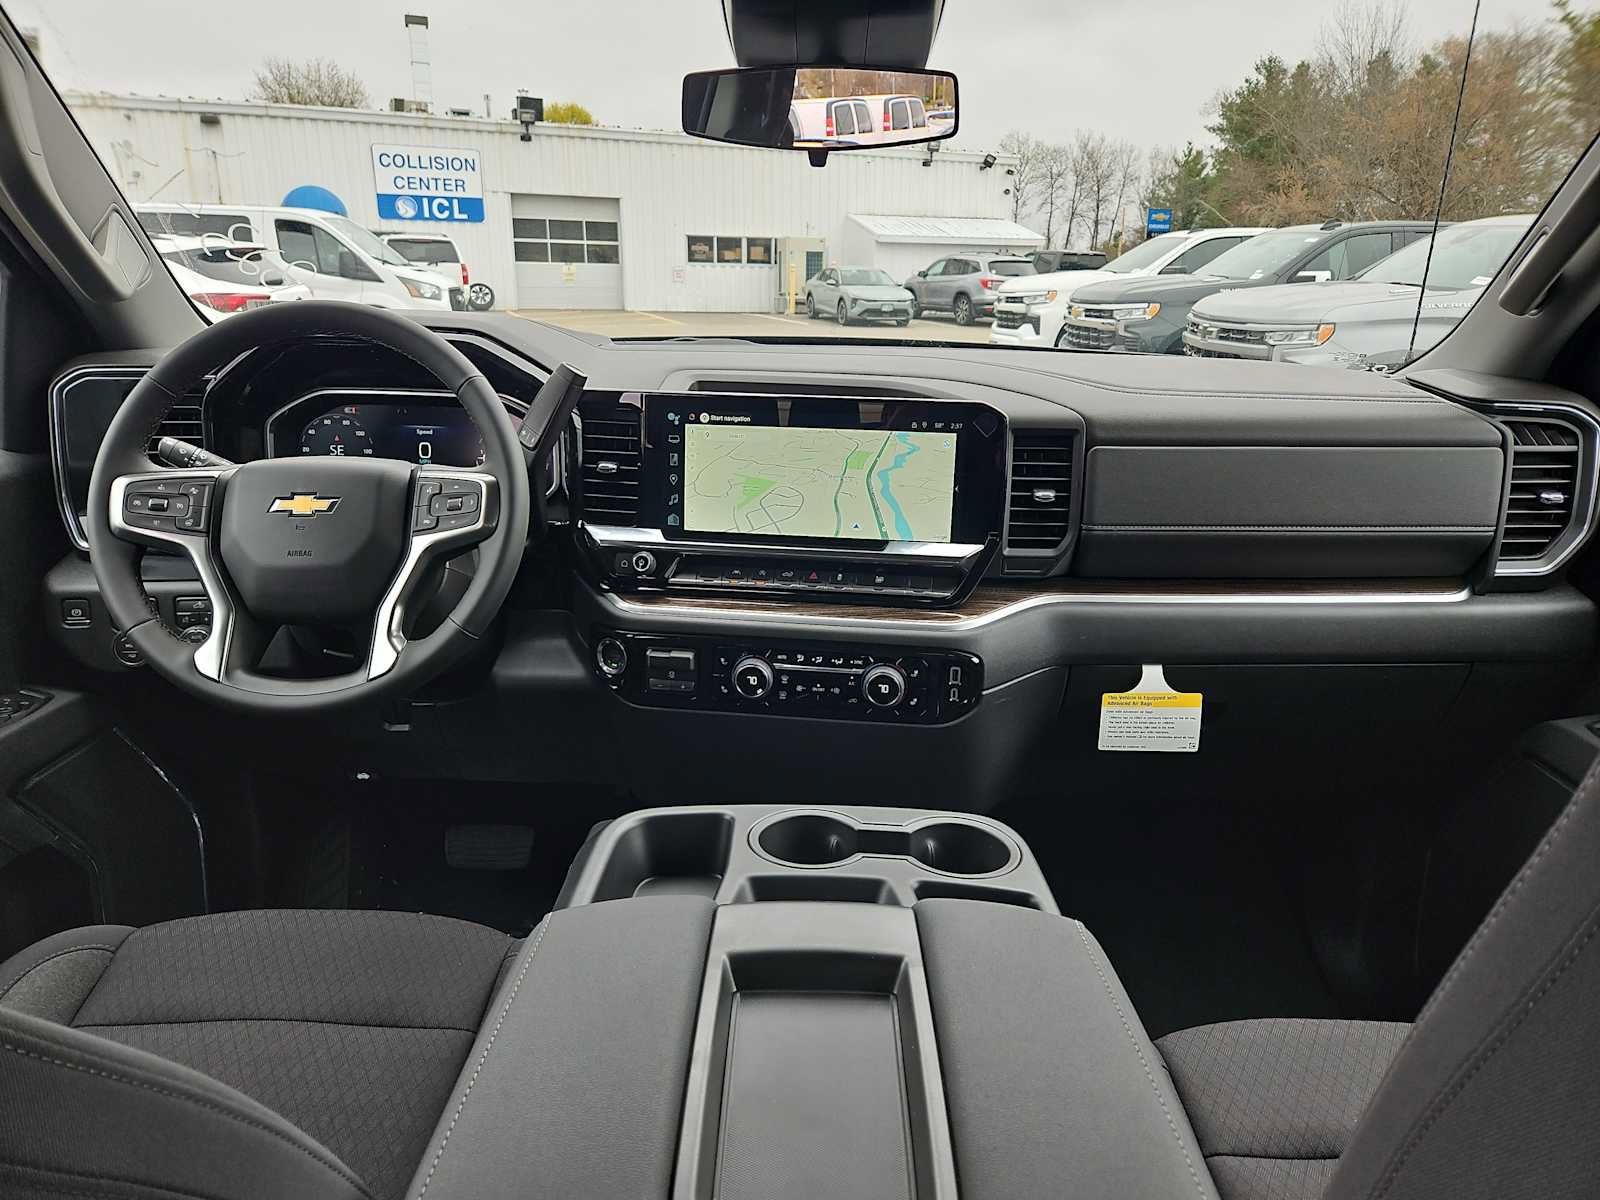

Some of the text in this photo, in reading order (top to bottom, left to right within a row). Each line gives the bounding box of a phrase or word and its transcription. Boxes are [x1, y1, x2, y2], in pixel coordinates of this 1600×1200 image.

[379, 153, 476, 172] COLLISION
[393, 175, 466, 192] CENTER
[422, 197, 469, 220] ICL
[724, 415, 751, 423] navigation
[416, 428, 433, 436] Speed
[329, 445, 345, 456] SE
[418, 441, 432, 459] 0
[286, 549, 313, 557] AIRBAG
[746, 674, 758, 686] 70
[877, 683, 890, 695] 70
